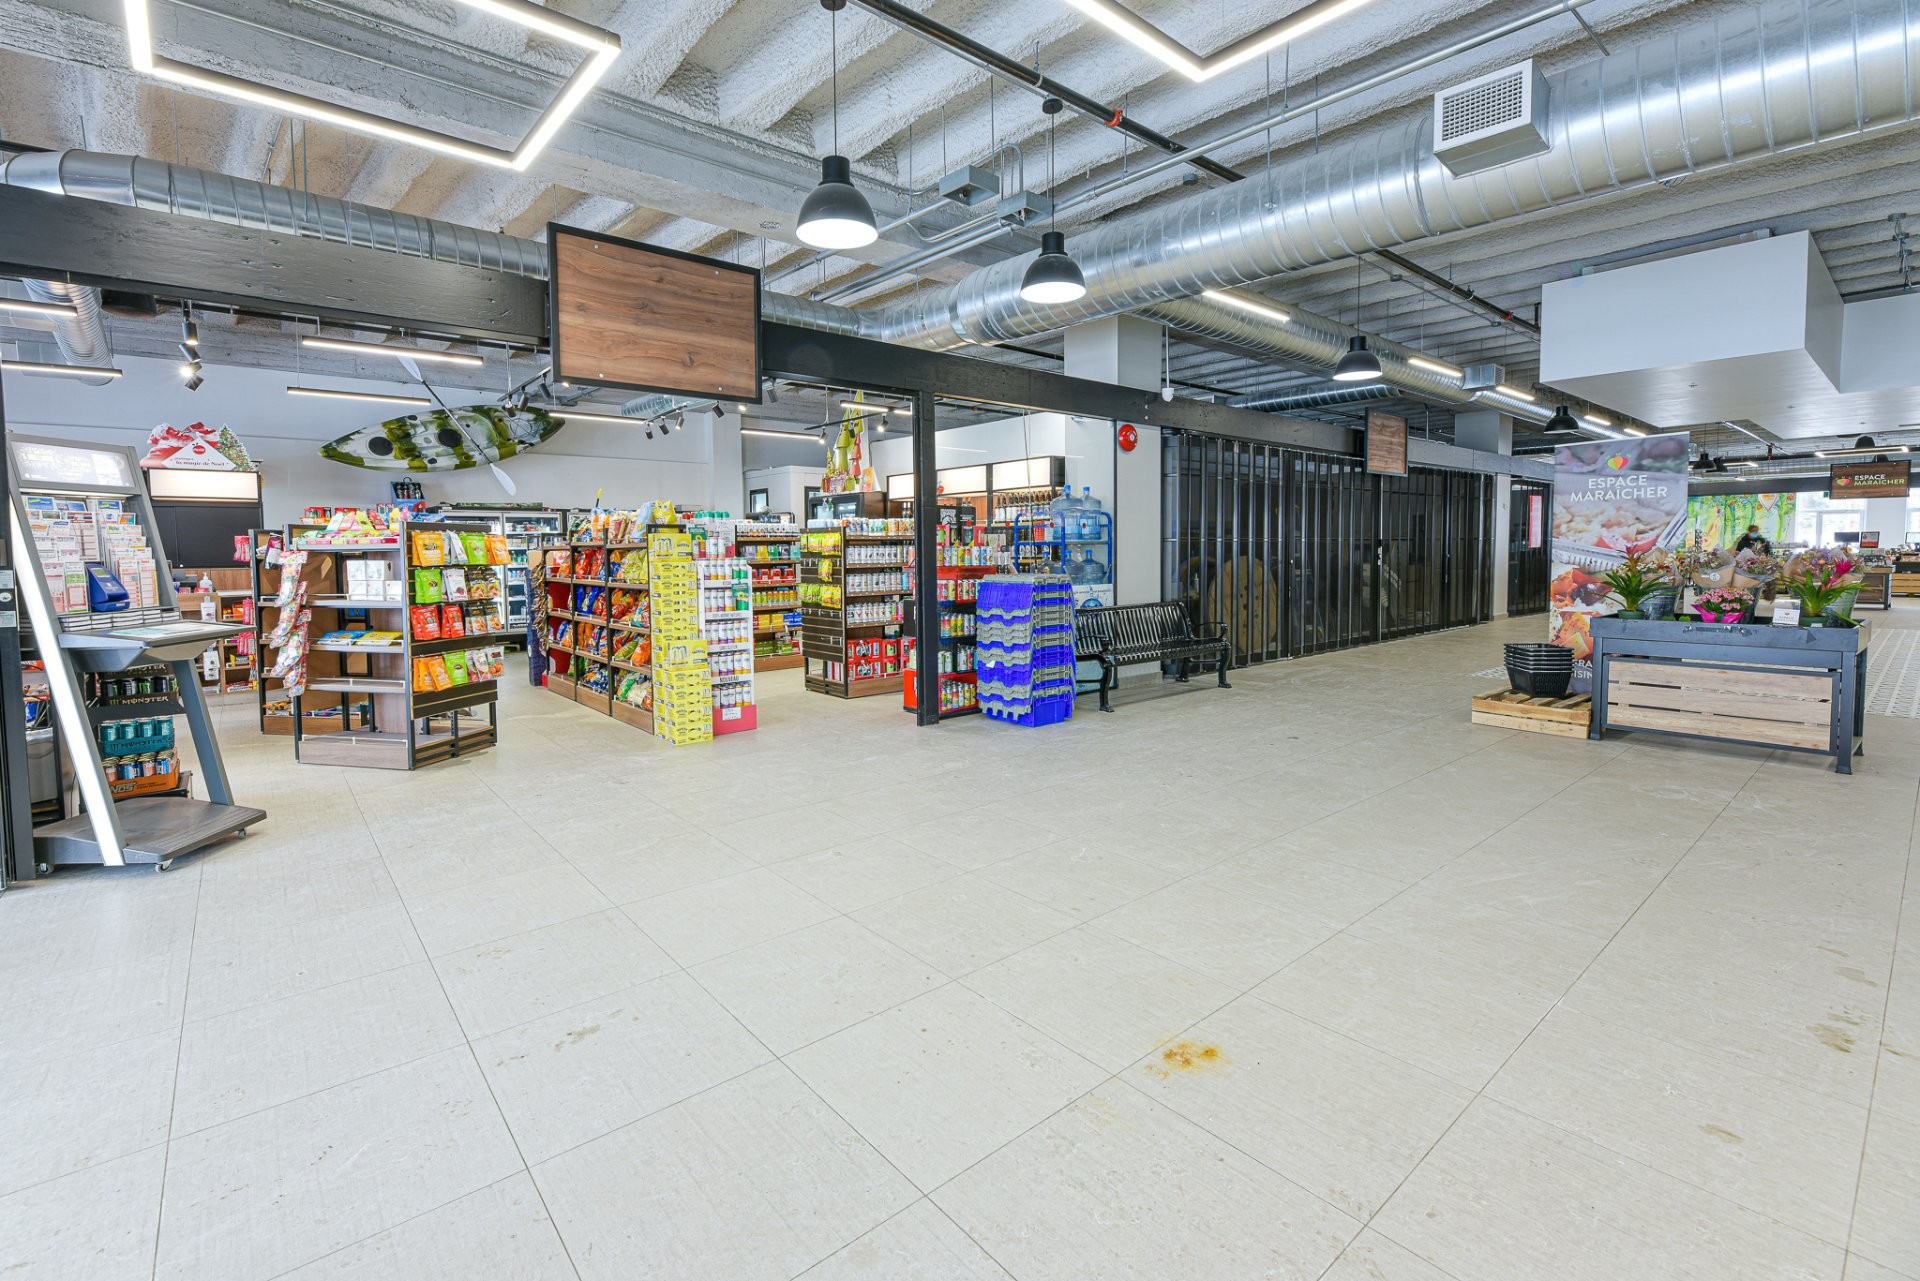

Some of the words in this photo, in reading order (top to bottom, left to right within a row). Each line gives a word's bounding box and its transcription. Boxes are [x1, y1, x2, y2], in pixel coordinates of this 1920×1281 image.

[1588, 474, 1648, 489] ESPACE
[1570, 486, 1668, 502] MARAÎCHER
[720, 675, 740, 683] NOUVEAU
[1570, 670, 1592, 679] ISIN
[122, 695, 169, 705] MONSTER
